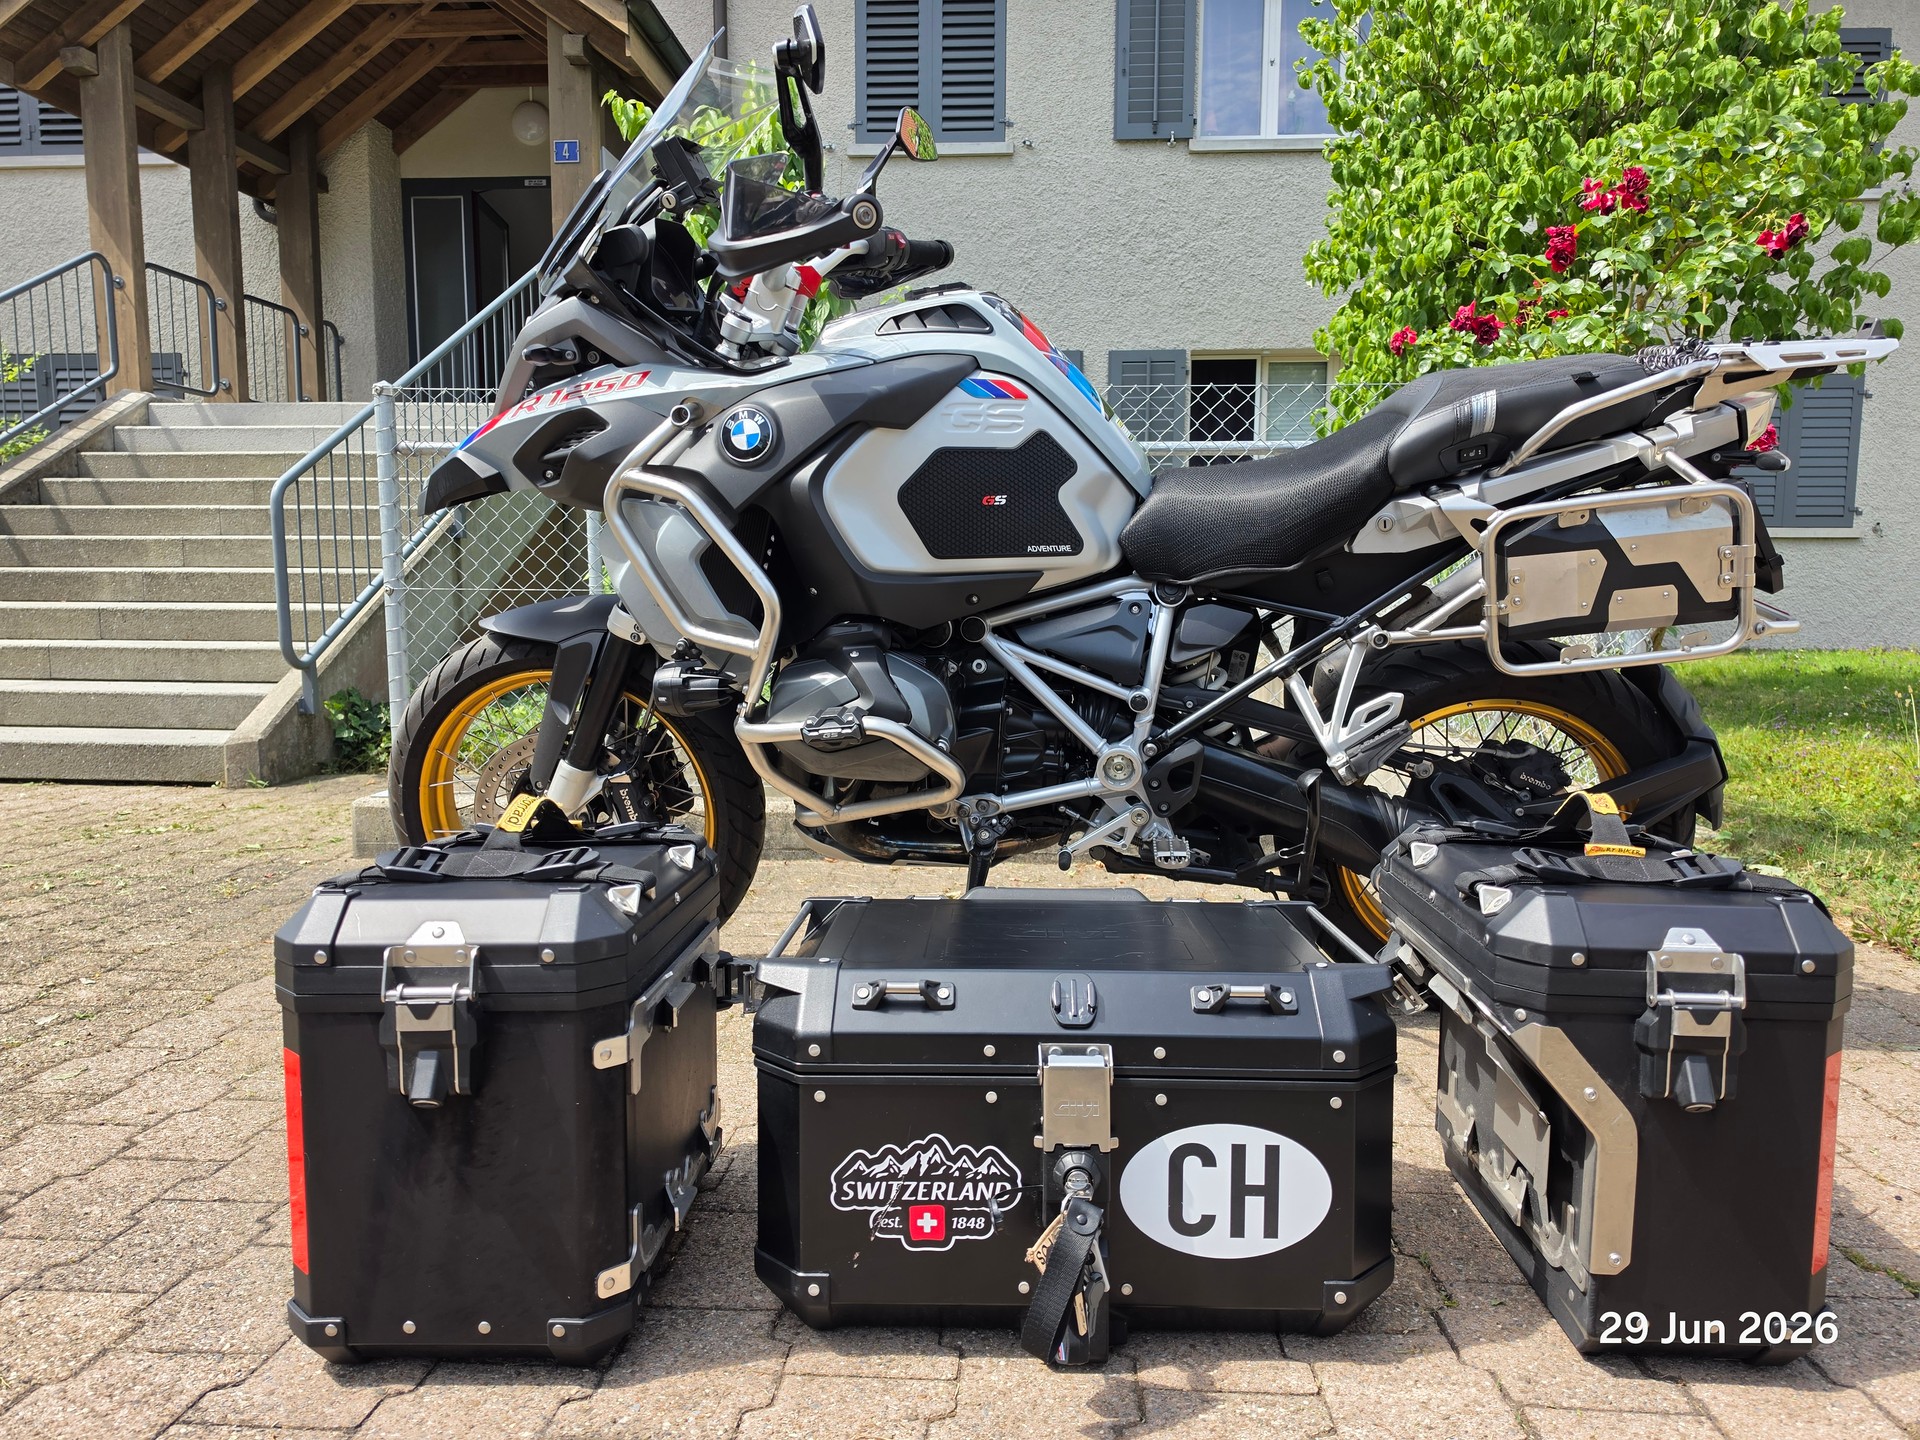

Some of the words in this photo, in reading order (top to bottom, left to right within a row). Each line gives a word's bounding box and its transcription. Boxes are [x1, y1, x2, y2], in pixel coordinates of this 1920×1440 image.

[562, 143, 570, 160] 4
[508, 395, 541, 420] R
[546, 370, 652, 407] 1250
[725, 410, 765, 430] BMW
[940, 402, 1026, 434] GS
[982, 494, 1008, 506] GS
[1027, 545, 1073, 553] ADVENTURE
[1520, 772, 1552, 791] brembo
[619, 788, 638, 822] bremb
[1052, 1100, 1100, 1118] GIVI
[841, 1181, 1012, 1201] SWITZERLAND
[1168, 1142, 1280, 1239] CH
[881, 1216, 903, 1229] est.
[951, 1216, 986, 1229] 1848
